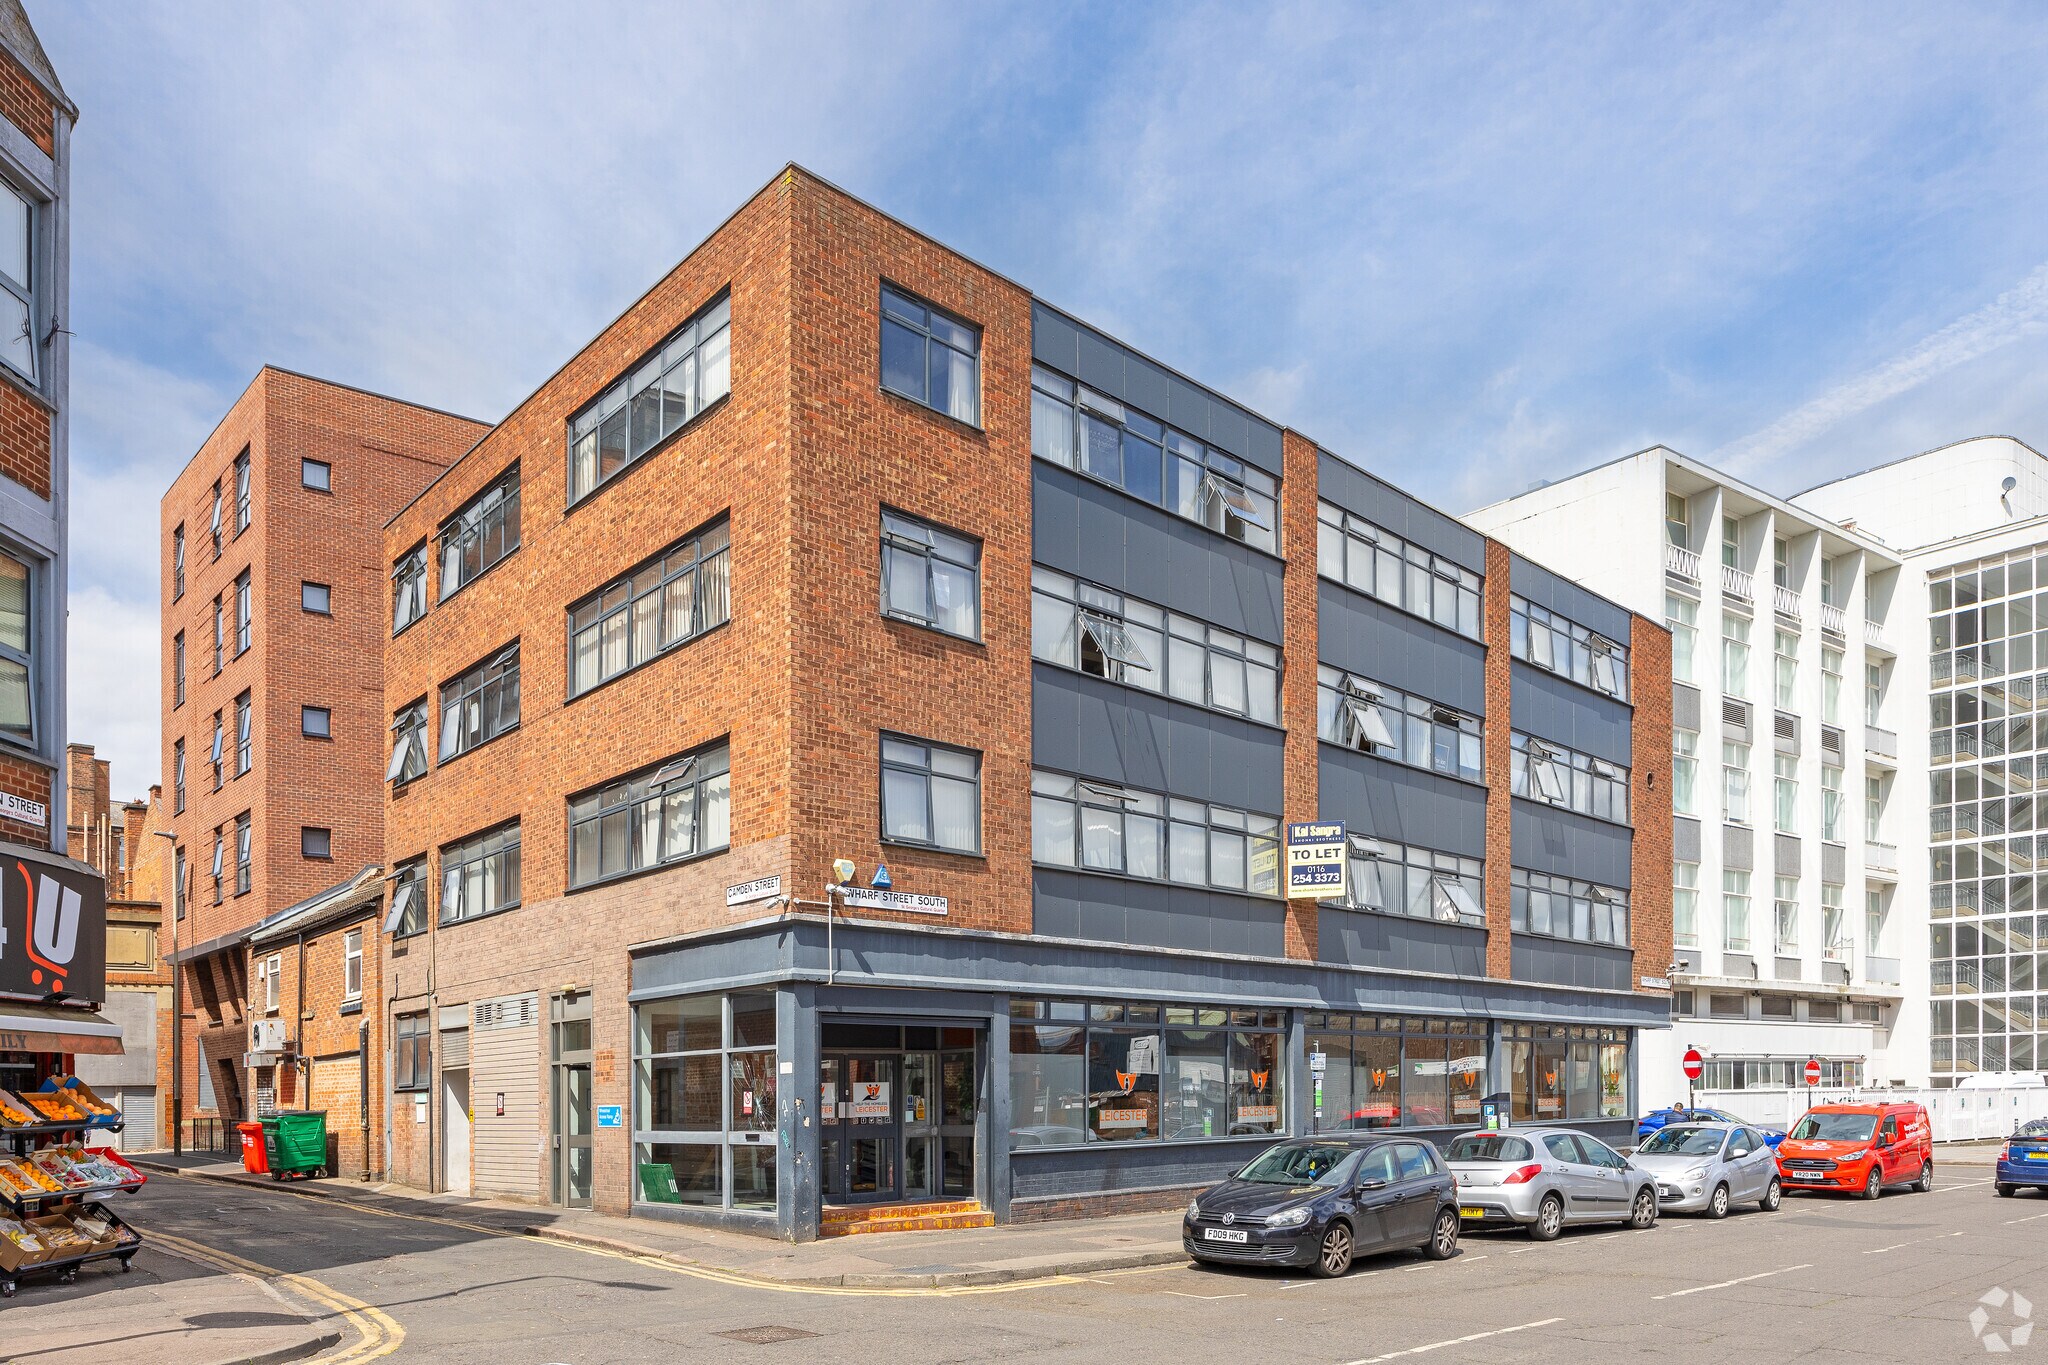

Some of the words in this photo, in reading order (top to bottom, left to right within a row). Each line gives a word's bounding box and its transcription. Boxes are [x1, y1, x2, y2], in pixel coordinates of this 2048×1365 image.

[8, 796, 44, 816] STREET
[1310, 825, 1341, 837] Sangra
[1292, 849, 1311, 860] TO
[1315, 848, 1341, 859] LET
[1307, 865, 1326, 873] 0116
[1293, 874, 1312, 884] 254
[1314, 872, 1340, 882] 3373
[728, 883, 753, 898] CAMDEN
[754, 877, 779, 892] STREET
[847, 889, 879, 900] WHARF
[882, 892, 914, 904] STREET
[918, 896, 946, 908] SOUTH
[1100, 1110, 1147, 1122] LEICESTER
[1237, 1106, 1277, 1117] LEICESTER
[1208, 1229, 1228, 1239] FD09
[1229, 1232, 1244, 1241] HKG
